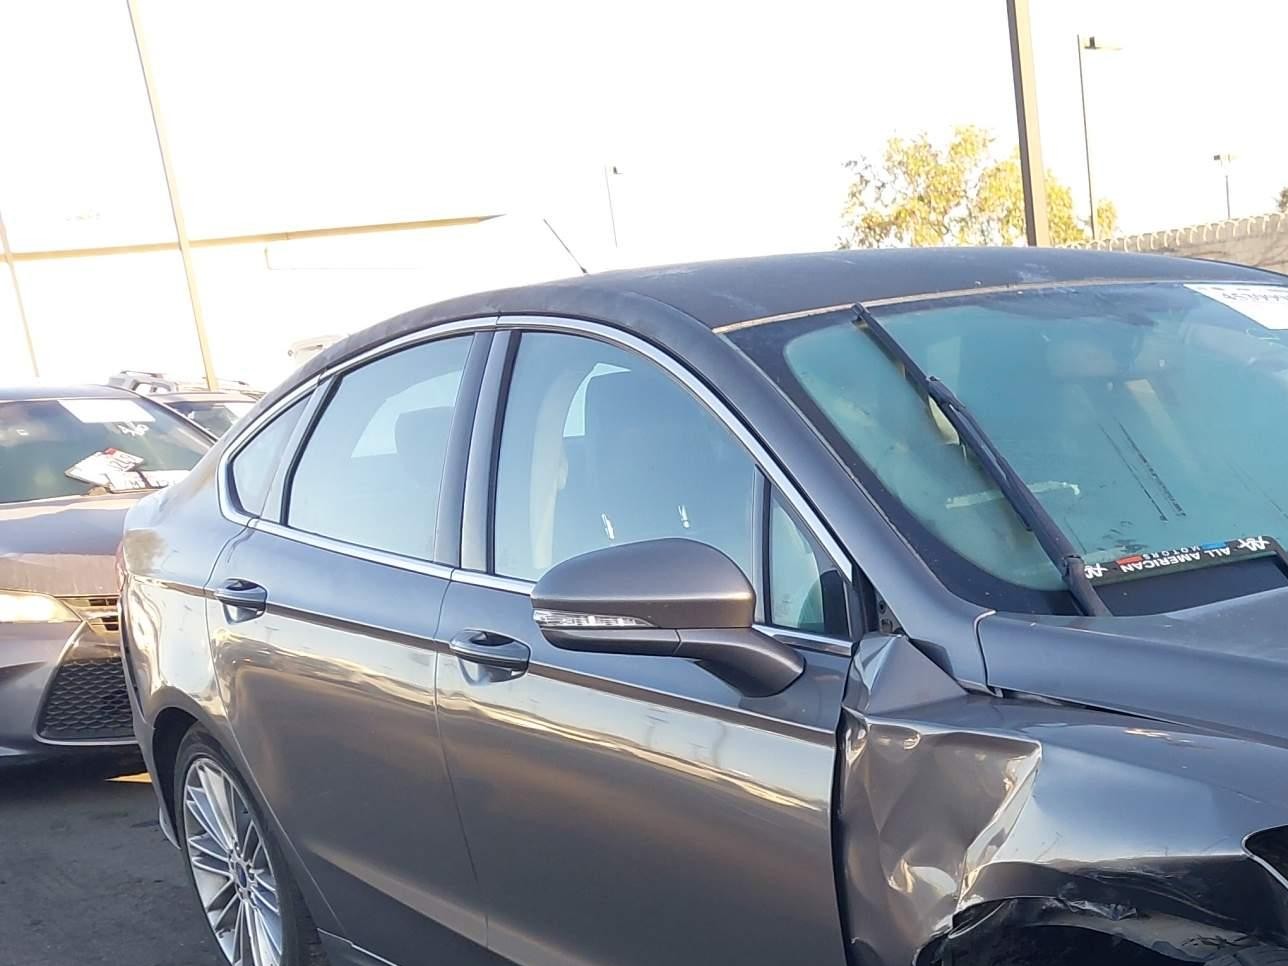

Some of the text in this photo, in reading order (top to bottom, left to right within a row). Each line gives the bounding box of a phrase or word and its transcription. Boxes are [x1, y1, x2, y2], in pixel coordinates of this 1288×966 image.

[1120, 547, 1231, 573] ALL AMERICAN
[1142, 546, 1201, 559] MOTORS
